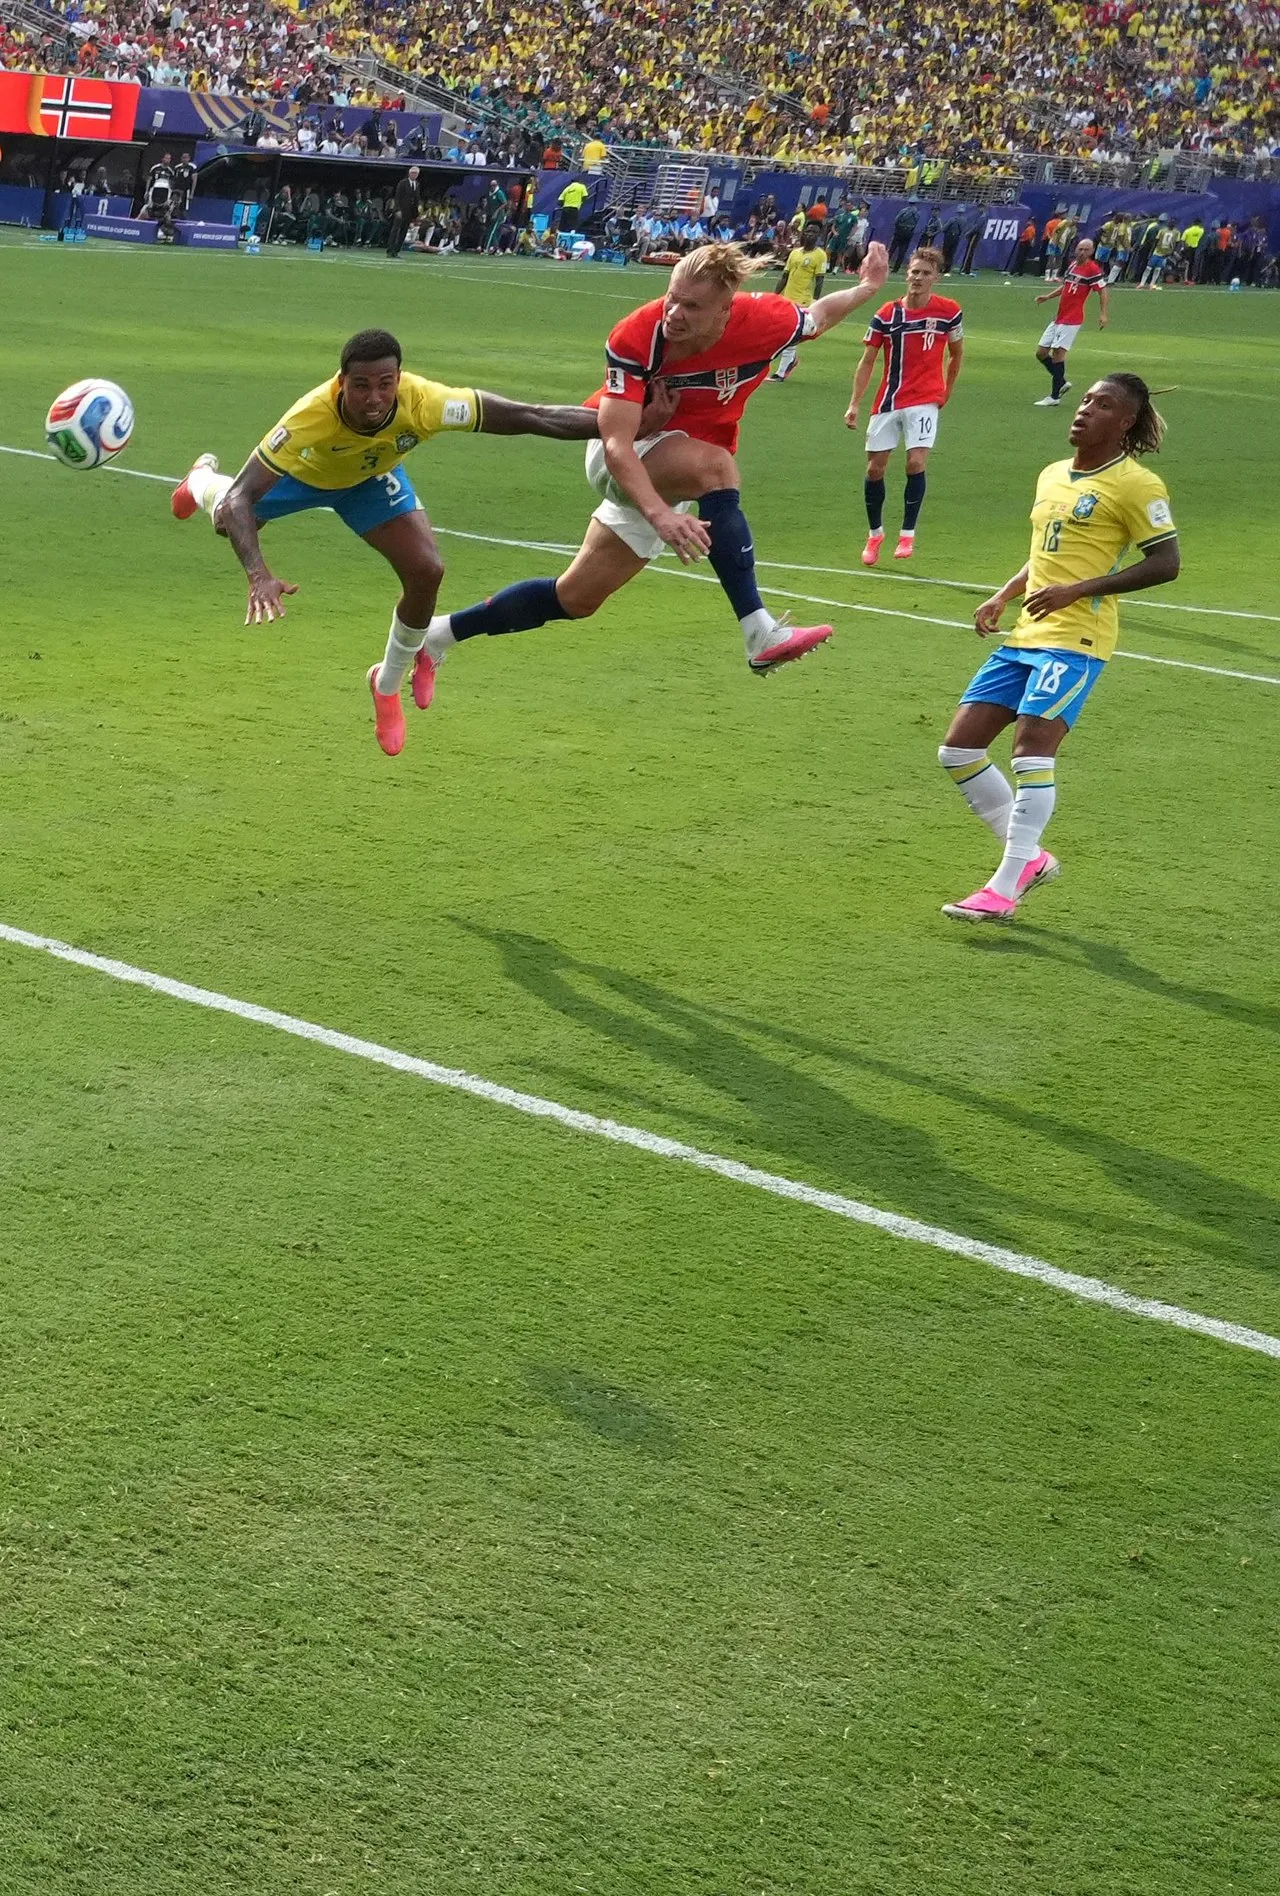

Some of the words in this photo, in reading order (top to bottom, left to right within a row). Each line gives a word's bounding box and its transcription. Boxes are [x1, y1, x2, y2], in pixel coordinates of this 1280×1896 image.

[983, 219, 1019, 240] FIFA
[919, 417, 932, 433] 10
[361, 456, 378, 469] 3
[375, 472, 401, 496] 3
[1042, 521, 1062, 552] 18
[1034, 660, 1069, 694] 18
